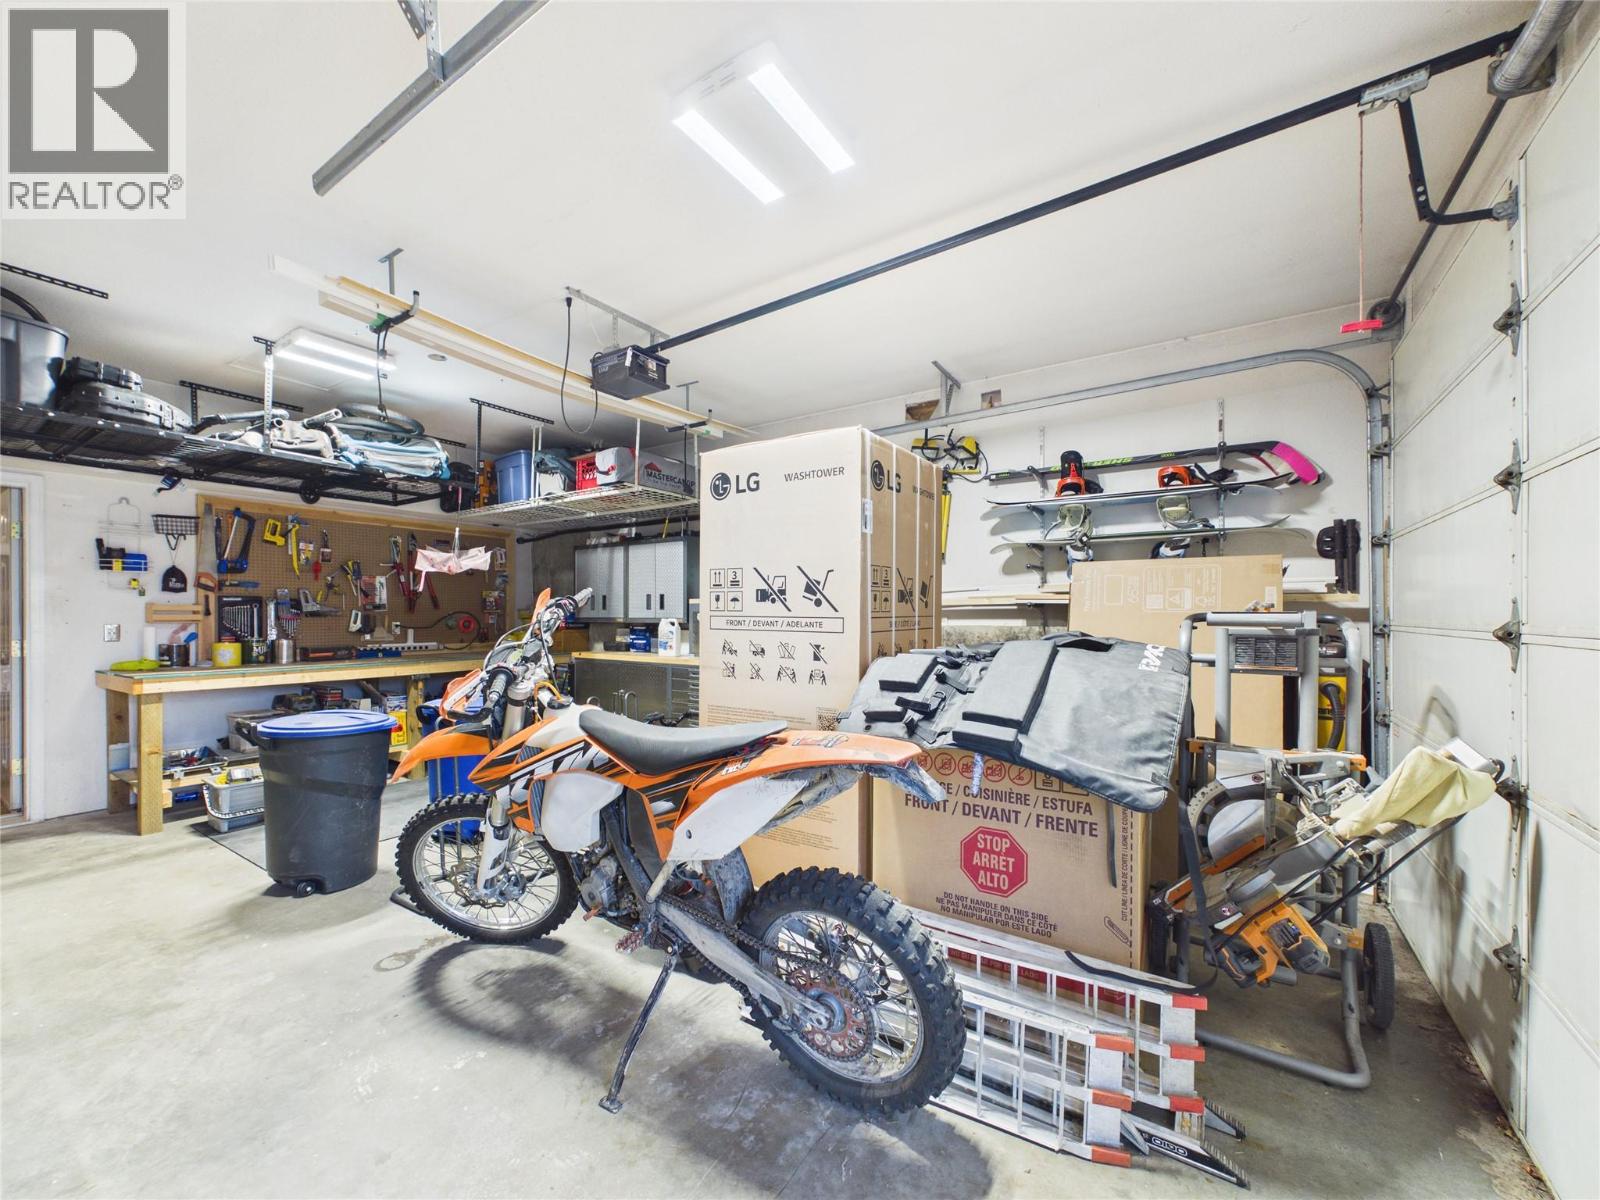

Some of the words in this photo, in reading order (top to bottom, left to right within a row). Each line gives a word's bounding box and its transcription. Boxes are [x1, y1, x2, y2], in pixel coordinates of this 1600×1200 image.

[735, 472, 760, 494] LG
[784, 466, 845, 482] WASHTOWER
[731, 571, 738, 580] 3
[726, 619, 746, 627] FRONT
[752, 619, 779, 627] DEVANT
[785, 620, 823, 629] ADELANTE
[905, 794, 949, 813] FRONT
[962, 802, 1022, 825] DEVANT
[1035, 813, 1098, 838] FRENTE
[1042, 800, 1093, 816] ESTUFA
[977, 833, 1010, 852] STOP
[978, 870, 1009, 890] ALTO
[947, 899, 959, 908] PAS
[962, 903, 1002, 918] MANIPULER
[1004, 913, 1024, 924] DANS
[1027, 919, 1037, 927] CE
[955, 895, 968, 903] NOT
[970, 899, 998, 910] HANDLE
[1000, 905, 1011, 913] ON
[1013, 908, 1029, 918] THIS
[1031, 912, 1049, 922] SIDE
[952, 908, 994, 924] MANIPULAR
[996, 919, 1010, 927] POR
[1012, 922, 1030, 933] ESTE
[1032, 926, 1052, 938] LADO
